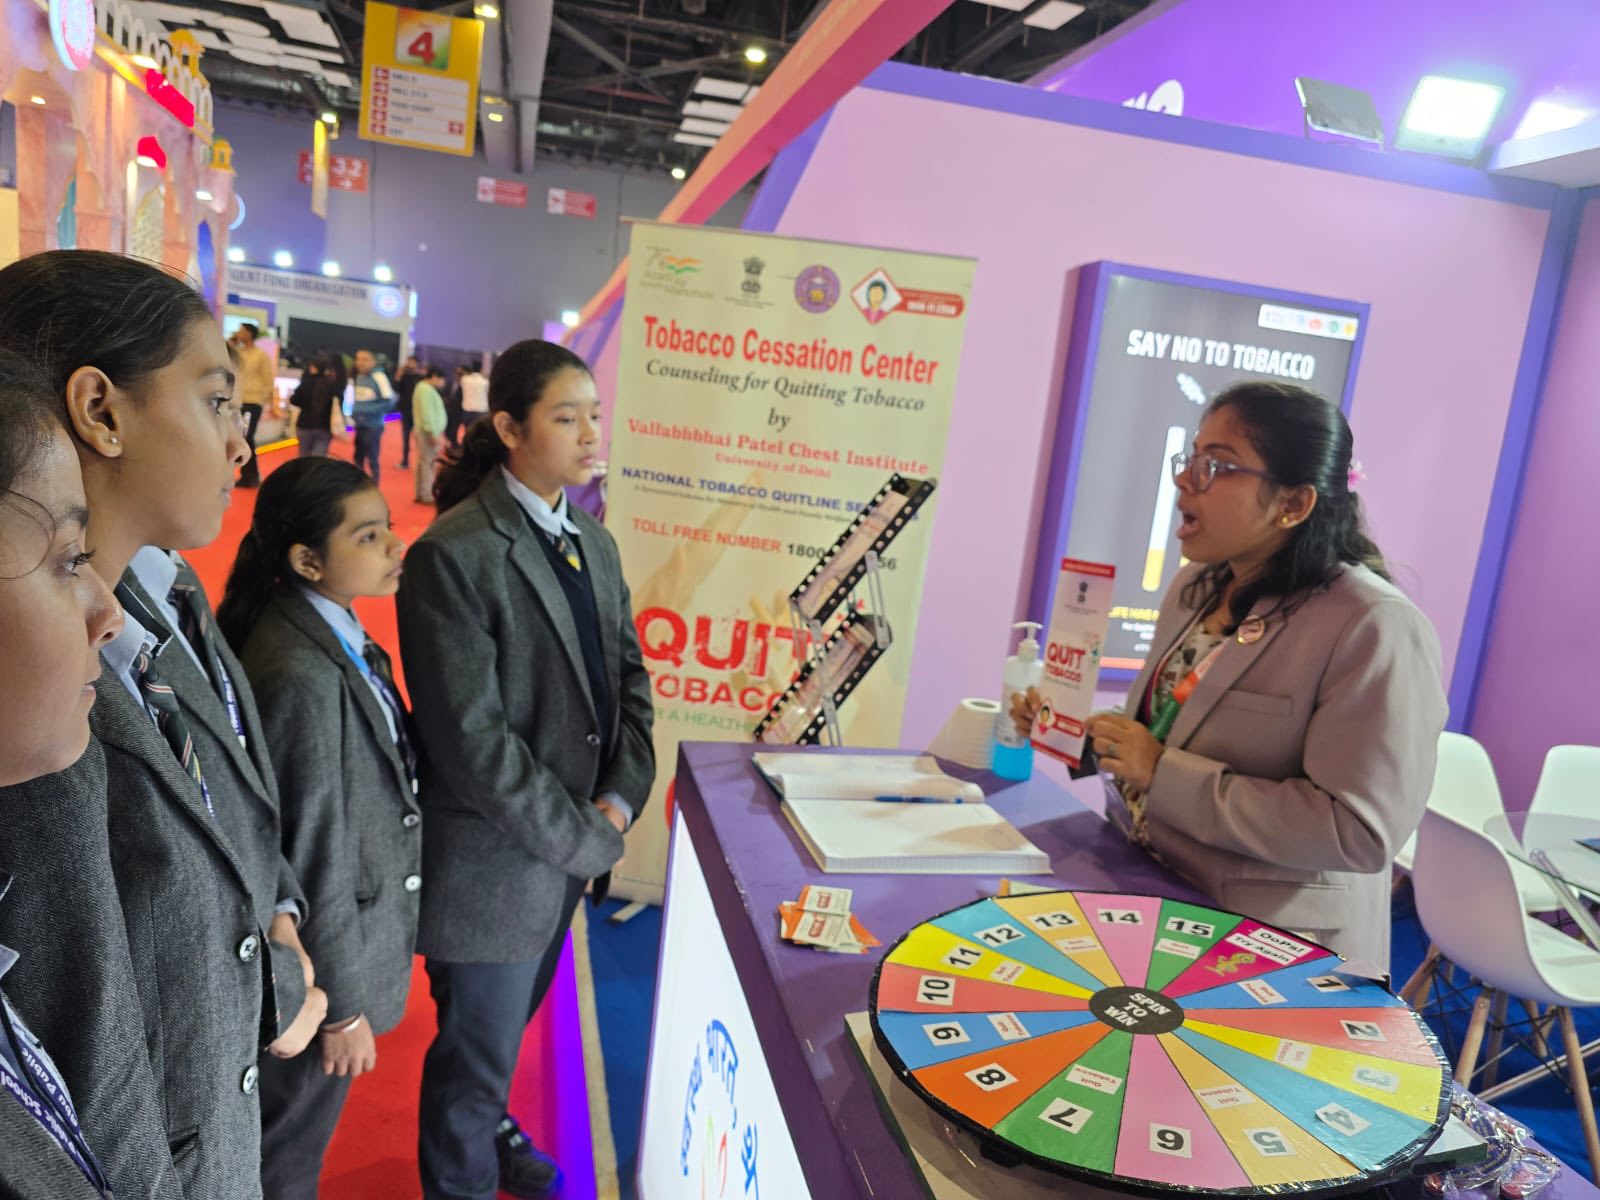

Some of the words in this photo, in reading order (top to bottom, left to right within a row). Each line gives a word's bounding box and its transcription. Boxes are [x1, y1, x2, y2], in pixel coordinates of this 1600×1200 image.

[407, 31, 436, 64] 4
[644, 315, 735, 358] Tobacco
[743, 329, 852, 375] Cessation
[861, 344, 939, 385] Center
[1126, 329, 1171, 358] SAY
[1171, 335, 1202, 363] NO
[1204, 340, 1230, 367] TO
[1232, 344, 1315, 380] TOBACCO
[646, 359, 738, 392] Counseling
[741, 371, 770, 393] for
[774, 380, 847, 406] Quitting
[852, 387, 925, 412] Tobacco
[767, 408, 791, 432] by
[715, 451, 781, 475] University
[783, 462, 796, 475] of
[799, 464, 831, 479] Delhi
[737, 434, 784, 456] Patel
[788, 442, 840, 463] Chest
[846, 449, 929, 475] Institute
[621, 467, 695, 488] NATIONAL
[699, 478, 768, 499] TOBACCO
[772, 489, 841, 510] QUITLINE
[632, 517, 669, 536] TOLL
[673, 525, 713, 543] FREE
[717, 532, 781, 551] NUMBER
[787, 543, 826, 559] 1800
[634, 607, 830, 682] QUIT
[1047, 642, 1086, 670] QUIT
[1046, 663, 1082, 683] TOBACCO
[648, 670, 784, 712] OBAC
[684, 712, 752, 732] HEALTH
[1035, 913, 1074, 928] 13
[1099, 911, 1140, 924] 14
[1168, 919, 1211, 936] 15
[983, 927, 1022, 944] 12
[948, 947, 982, 966] 11
[1234, 935, 1253, 948] Try
[1254, 945, 1290, 963] Again
[922, 978, 950, 1001] 10
[1316, 978, 1342, 988] 1
[1122, 1001, 1148, 1018] TO
[1128, 992, 1172, 1016] SPIN
[1103, 1005, 1139, 1027] WIN
[932, 1026, 961, 1040] 9
[1345, 1021, 1379, 1037] 2
[22, 1047, 56, 1095] Public
[975, 1068, 1006, 1086] 8
[0, 1070, 43, 1117] School
[1048, 1107, 1078, 1128] 7
[1322, 1109, 1356, 1131] 4
[1156, 1129, 1184, 1151] 6
[1252, 1131, 1288, 1154] 5
